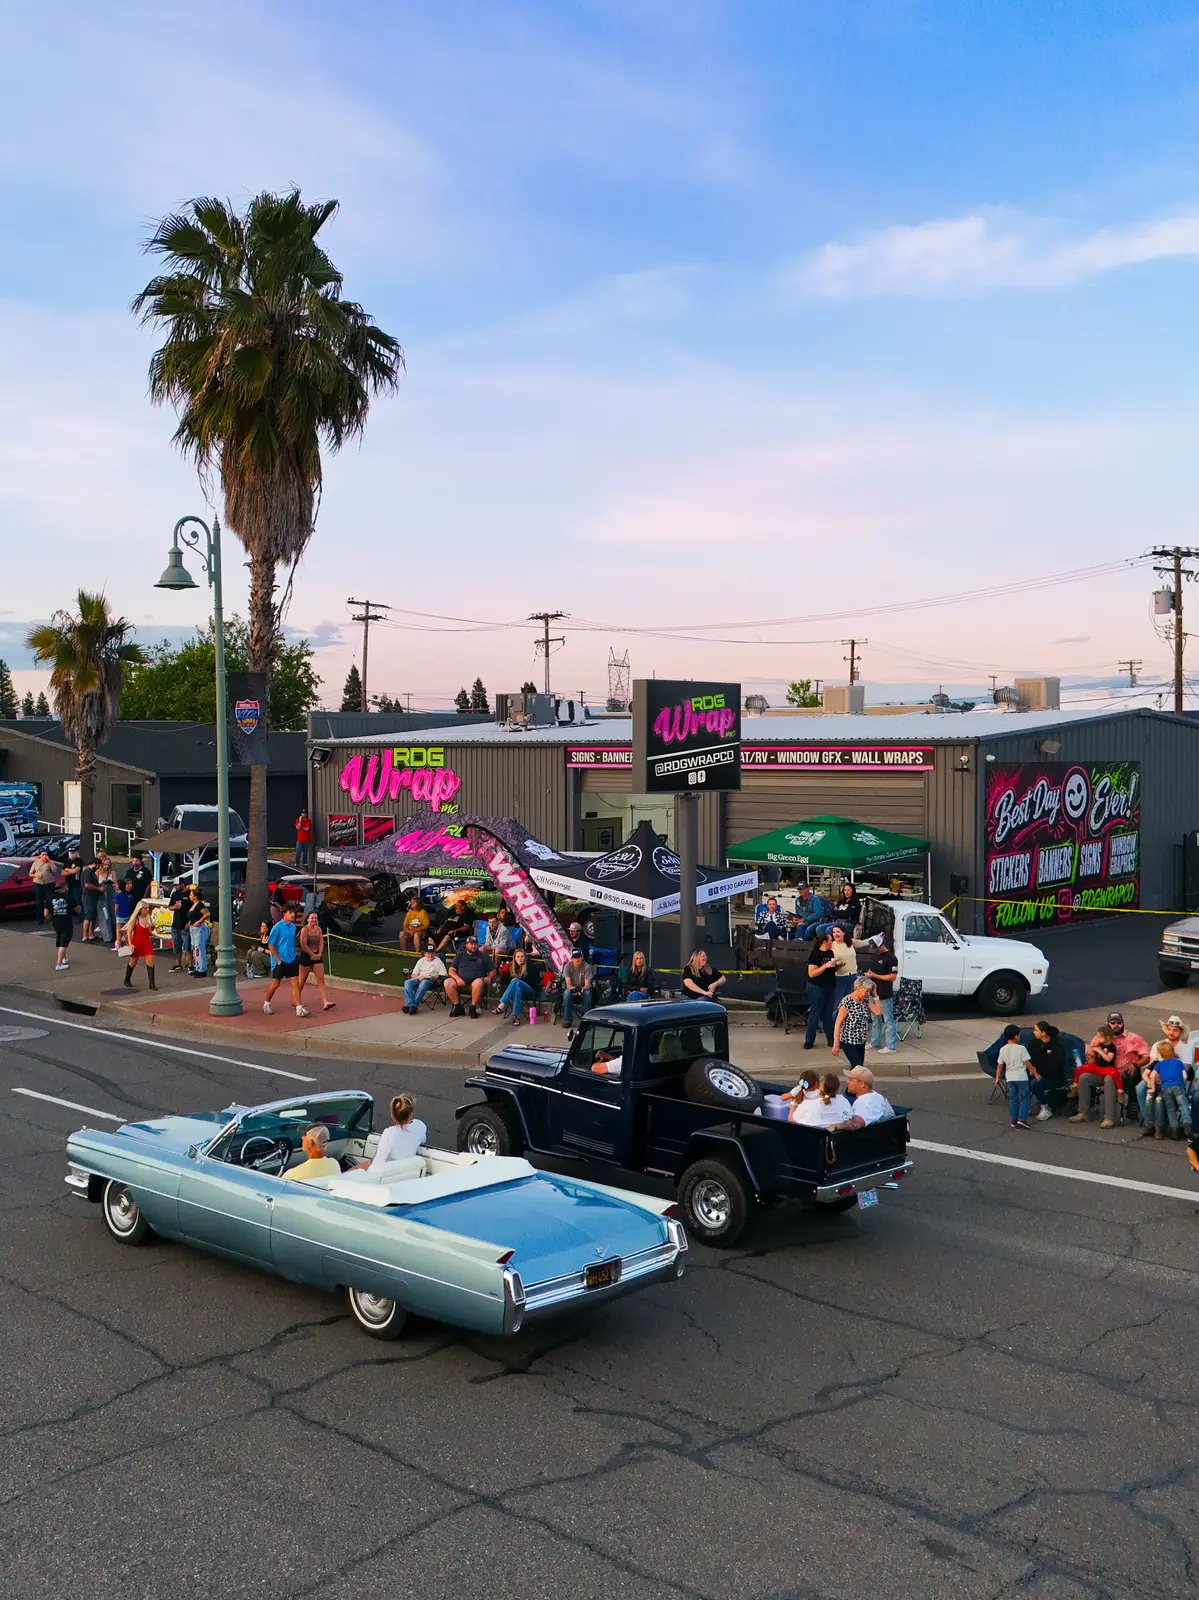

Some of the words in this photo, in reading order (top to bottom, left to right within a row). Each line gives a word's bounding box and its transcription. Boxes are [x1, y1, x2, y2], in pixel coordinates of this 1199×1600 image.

[691, 693, 725, 712] RDG
[653, 700, 736, 744] Wrap
[393, 747, 444, 767] RDG
[571, 752, 595, 763] SIGNS
[654, 750, 735, 776] @RDGWRAPCO
[777, 751, 820, 764] WINDOW
[822, 751, 842, 764] GFX
[851, 752, 882, 764] WALL
[884, 752, 923, 764] WRAPS
[338, 748, 461, 813] Wrap
[996, 791, 1032, 842] Best
[1033, 779, 1061, 825] Day
[1091, 774, 1138, 830] Ever!
[1111, 834, 1136, 855] WINDOW
[767, 853, 778, 862] Big
[778, 854, 797, 862] Green
[796, 855, 809, 864] Egg
[1038, 846, 1073, 884] BANNERS
[1079, 841, 1102, 877] SIGNS
[1110, 853, 1136, 875] GRAPHICS
[990, 853, 1030, 893] STICKERS
[1074, 883, 1135, 910] @RDGWRAPCO
[489, 850, 572, 974] WRAPS
[996, 899, 1038, 927] FOLLOW
[1040, 896, 1055, 919] US
